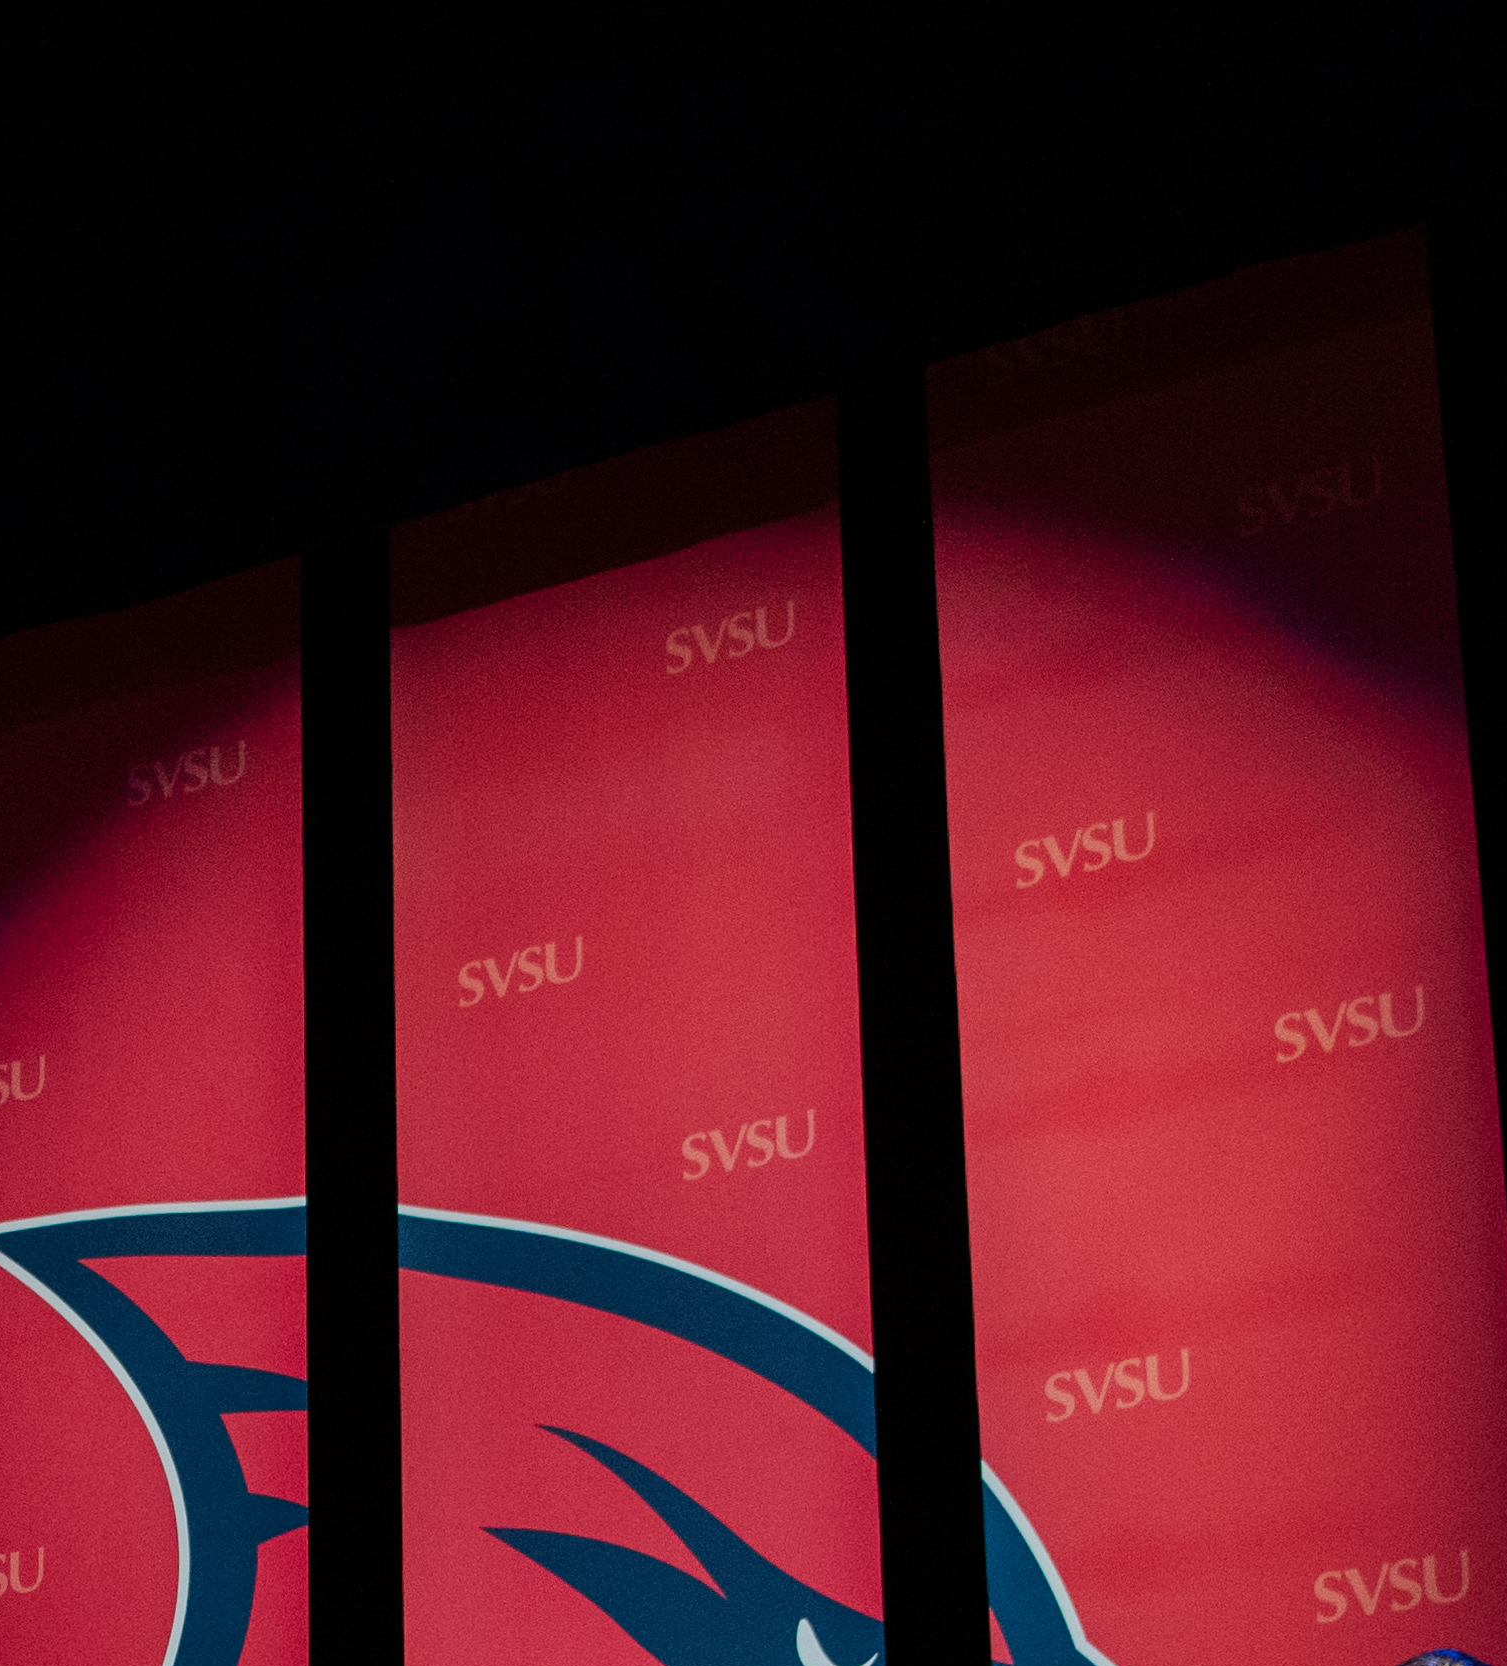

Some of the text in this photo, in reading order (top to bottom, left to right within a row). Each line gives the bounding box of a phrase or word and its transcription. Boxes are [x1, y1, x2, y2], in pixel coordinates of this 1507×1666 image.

[1236, 453, 1386, 531] SVSU
[665, 597, 797, 675] SVSU
[126, 739, 249, 808] SVSU
[1013, 810, 1157, 889] SVSU
[457, 935, 585, 1008] SVSU
[1273, 985, 1426, 1063] SVSU
[681, 1108, 816, 1181] SVSU
[1043, 1347, 1191, 1424] SVSU
[1313, 1548, 1471, 1625] SVSU
